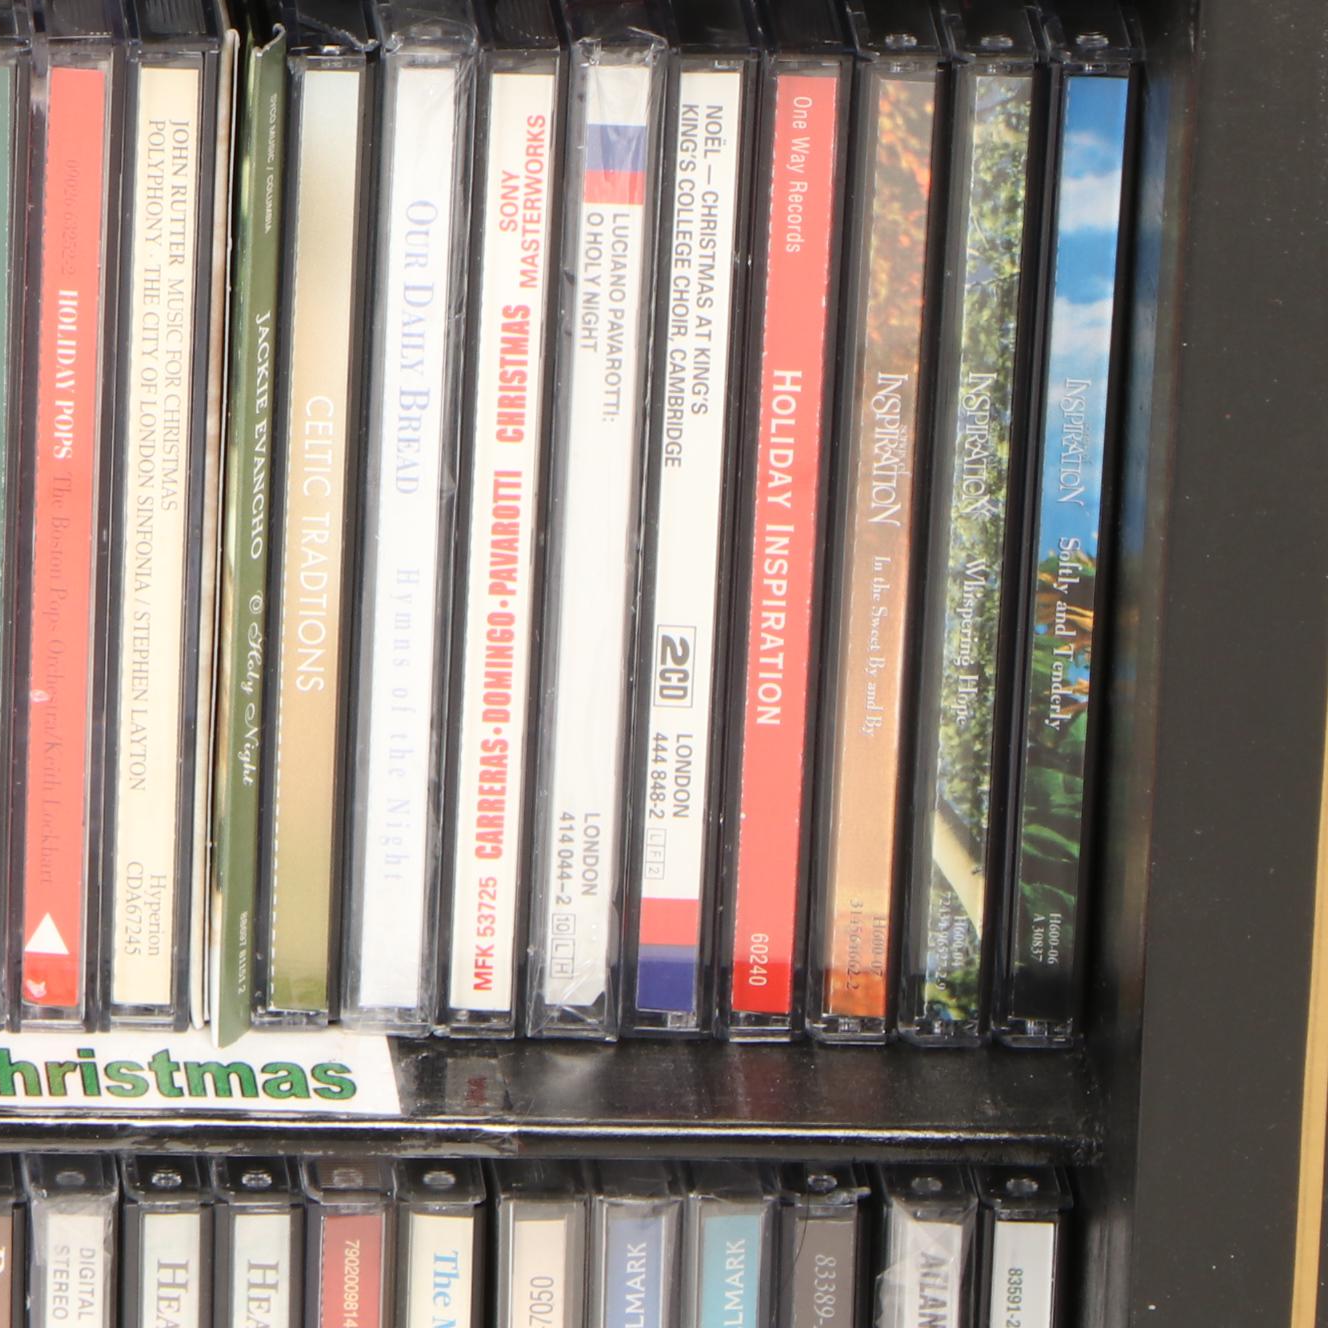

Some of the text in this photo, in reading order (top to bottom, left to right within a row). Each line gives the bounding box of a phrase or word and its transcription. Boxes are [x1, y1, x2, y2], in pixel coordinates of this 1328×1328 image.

[692, 105, 727, 415] NOËL CHRISTMAS AT KING'S
[748, 370, 802, 985] HOLIDAY INSPIRATION 60240
[52, 1245, 70, 1320] STEREO
[77, 1247, 96, 1321] DIGITAL
[432, 1249, 460, 1307] The
